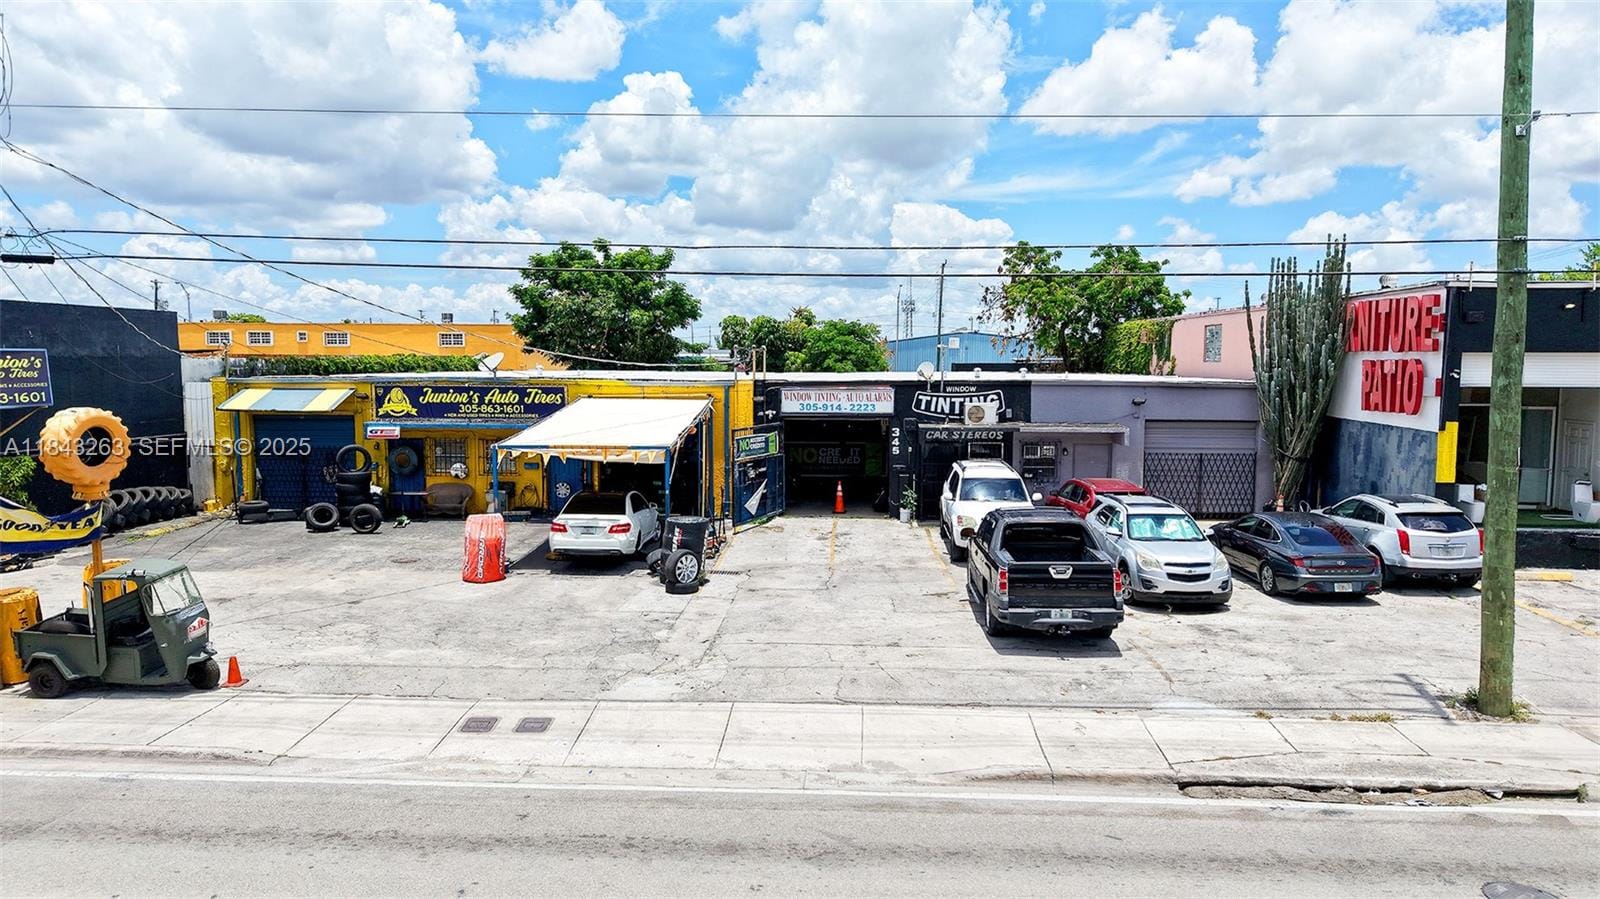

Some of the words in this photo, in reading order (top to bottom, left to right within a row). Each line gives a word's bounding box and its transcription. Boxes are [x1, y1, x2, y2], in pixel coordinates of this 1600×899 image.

[9, 368, 39, 378] Tires
[1361, 358, 1424, 415] PATIO
[420, 387, 480, 404] Junior's
[484, 388, 520, 404] Auto
[524, 388, 563, 404] Tires
[783, 391, 812, 401] WINDOW
[814, 391, 841, 402] TINTING
[846, 392, 864, 402] AUTO
[866, 391, 893, 402] ALARMS
[459, 404, 524, 413] 305-863-1601
[926, 430, 948, 439] CAR
[952, 430, 1004, 439] STEREOS
[739, 438, 750, 451] NO
[819, 447, 861, 456] CREIT
